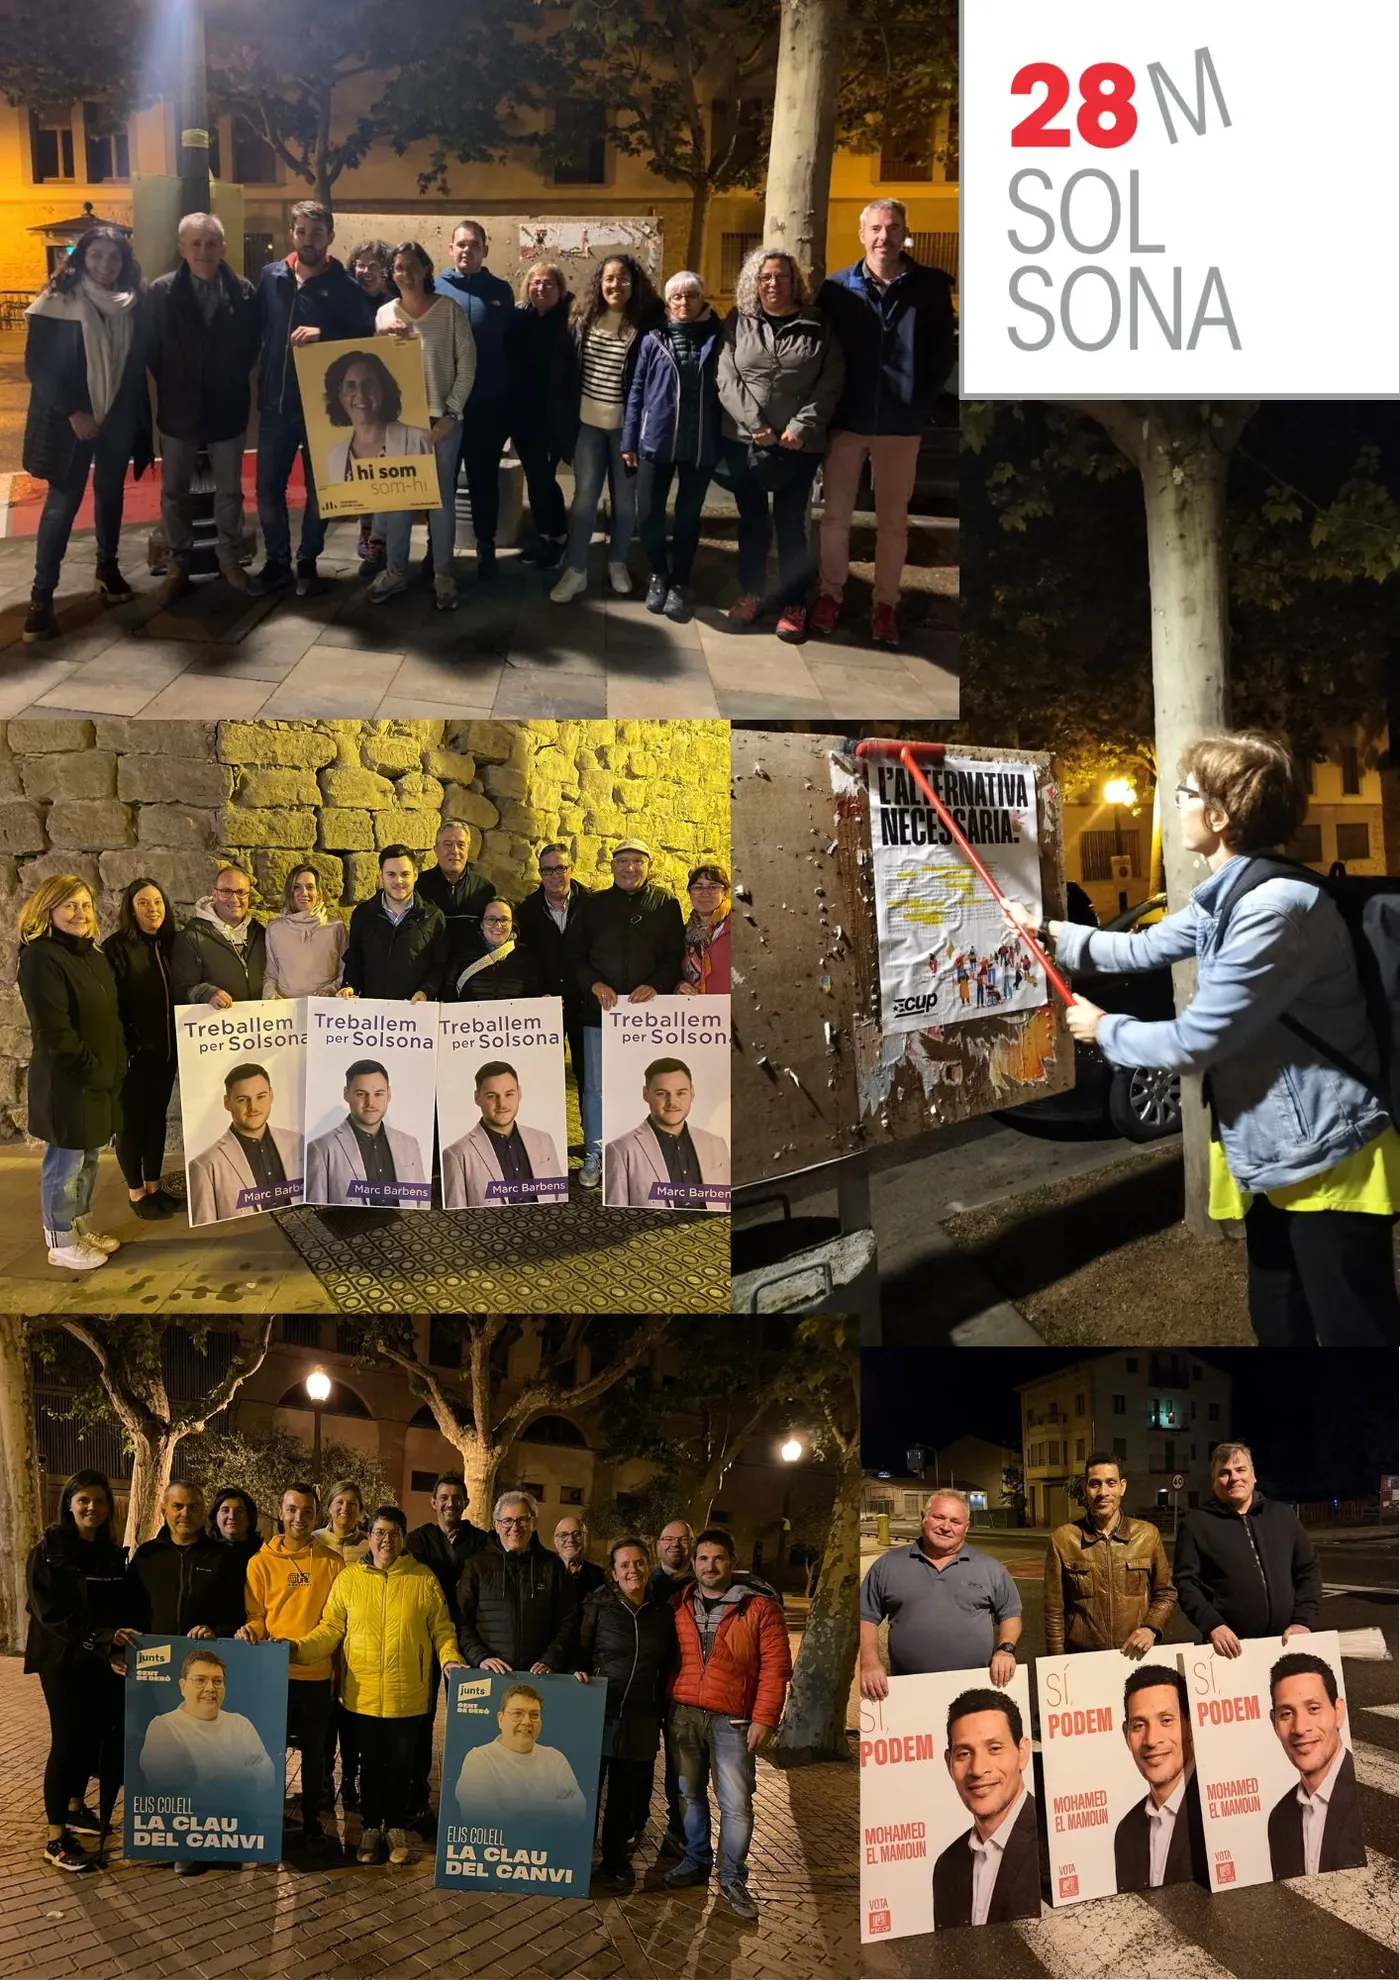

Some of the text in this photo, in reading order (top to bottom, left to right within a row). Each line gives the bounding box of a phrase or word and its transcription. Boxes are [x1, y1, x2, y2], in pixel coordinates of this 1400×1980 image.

[357, 464, 417, 480] hi som
[370, 478, 428, 495] som-hi
[184, 1016, 293, 1037] Treballem
[314, 1013, 417, 1032] Treballem
[439, 1015, 541, 1035] Treballem
[609, 1011, 721, 1028] Treballem
[326, 1031, 434, 1049] per Solsona
[452, 1030, 559, 1050] per Solsona
[622, 1029, 731, 1045] per Solson
[199, 1040, 224, 1054] per
[244, 1190, 272, 1203] Marc
[354, 1184, 429, 1198] Marc Barbens
[492, 1181, 566, 1195] Marc Barbens
[657, 1186, 686, 1197] Marc
[138, 1652, 165, 1663] junts
[460, 1685, 486, 1696] junts
[1196, 1695, 1261, 1727] PODEM
[1047, 1706, 1113, 1740] PODEM
[860, 1733, 934, 1768] PODEM
[1206, 1777, 1259, 1801] MOHAMED
[133, 1796, 193, 1815] ELIS COLELL
[1053, 1789, 1108, 1815] MOHAMED
[1208, 1795, 1262, 1820] EL MAMOUN
[133, 1815, 238, 1832] LA CLAU
[1055, 1808, 1109, 1833] EL MAMOUN
[133, 1832, 264, 1850] DEL CANVI
[447, 1825, 505, 1847] ELIS COLELL
[864, 1821, 926, 1845] MOHAMED
[446, 1845, 548, 1865] LA CLAU
[866, 1840, 927, 1865] EL MAMOUN
[1214, 1850, 1233, 1861] VOTA
[445, 1860, 573, 1884] DEL CANVI
[1058, 1863, 1076, 1876] VOTA
[869, 1898, 889, 1911] VOTA
